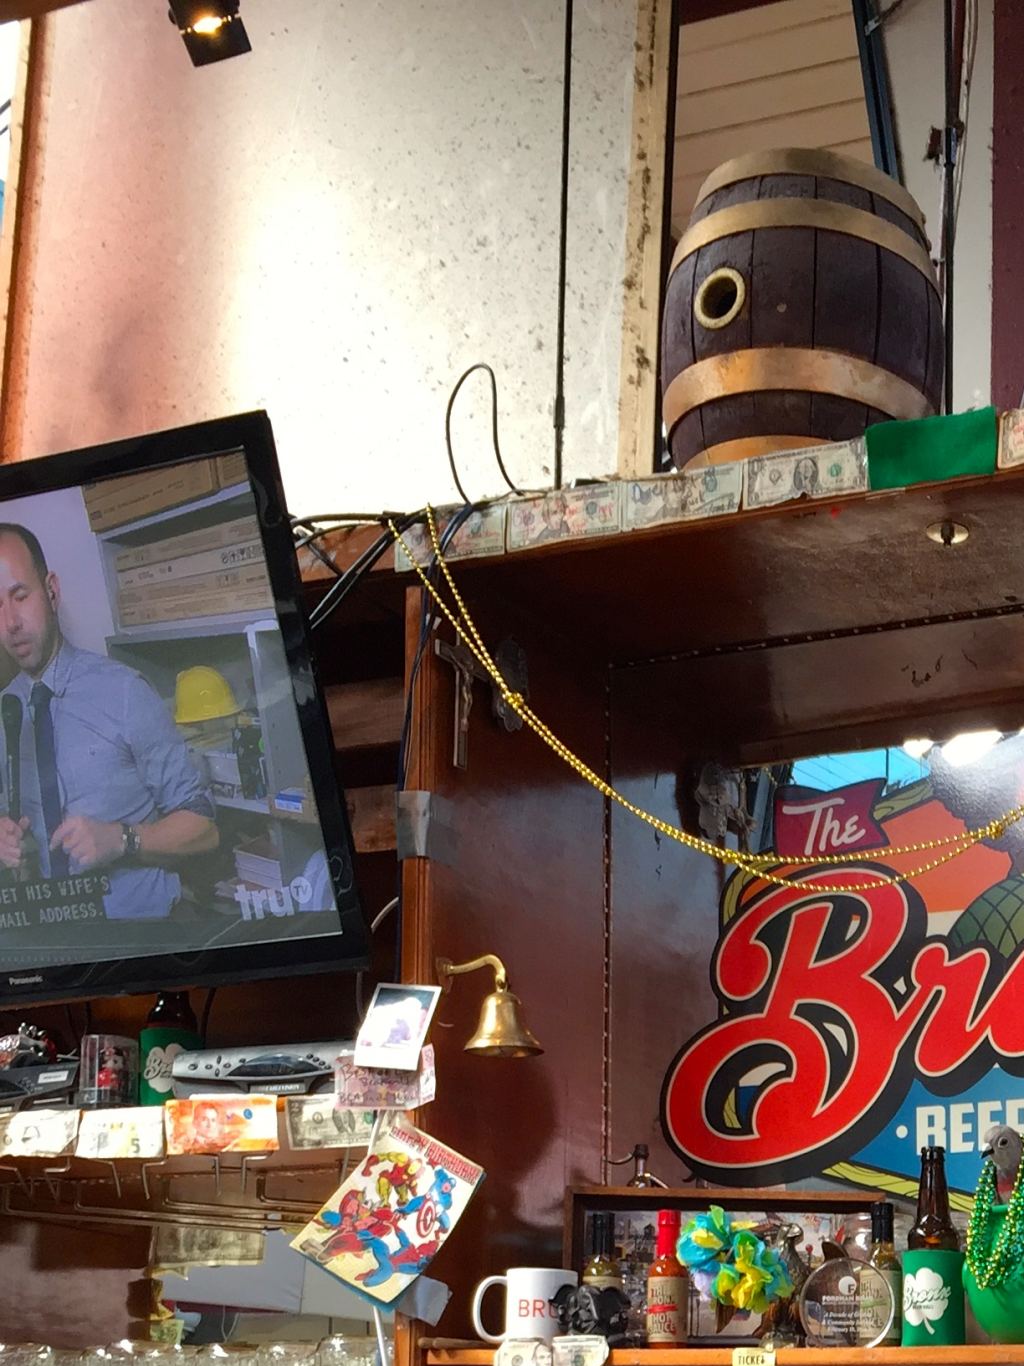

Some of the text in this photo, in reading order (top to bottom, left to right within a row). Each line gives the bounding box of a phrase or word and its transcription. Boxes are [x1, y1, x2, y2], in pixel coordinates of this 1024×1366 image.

[800, 797, 866, 856] The
[0, 876, 110, 904] ET HIS WIFE'S
[40, 902, 103, 923] ADDRESS.
[904, 1284, 952, 1311] Bronx
